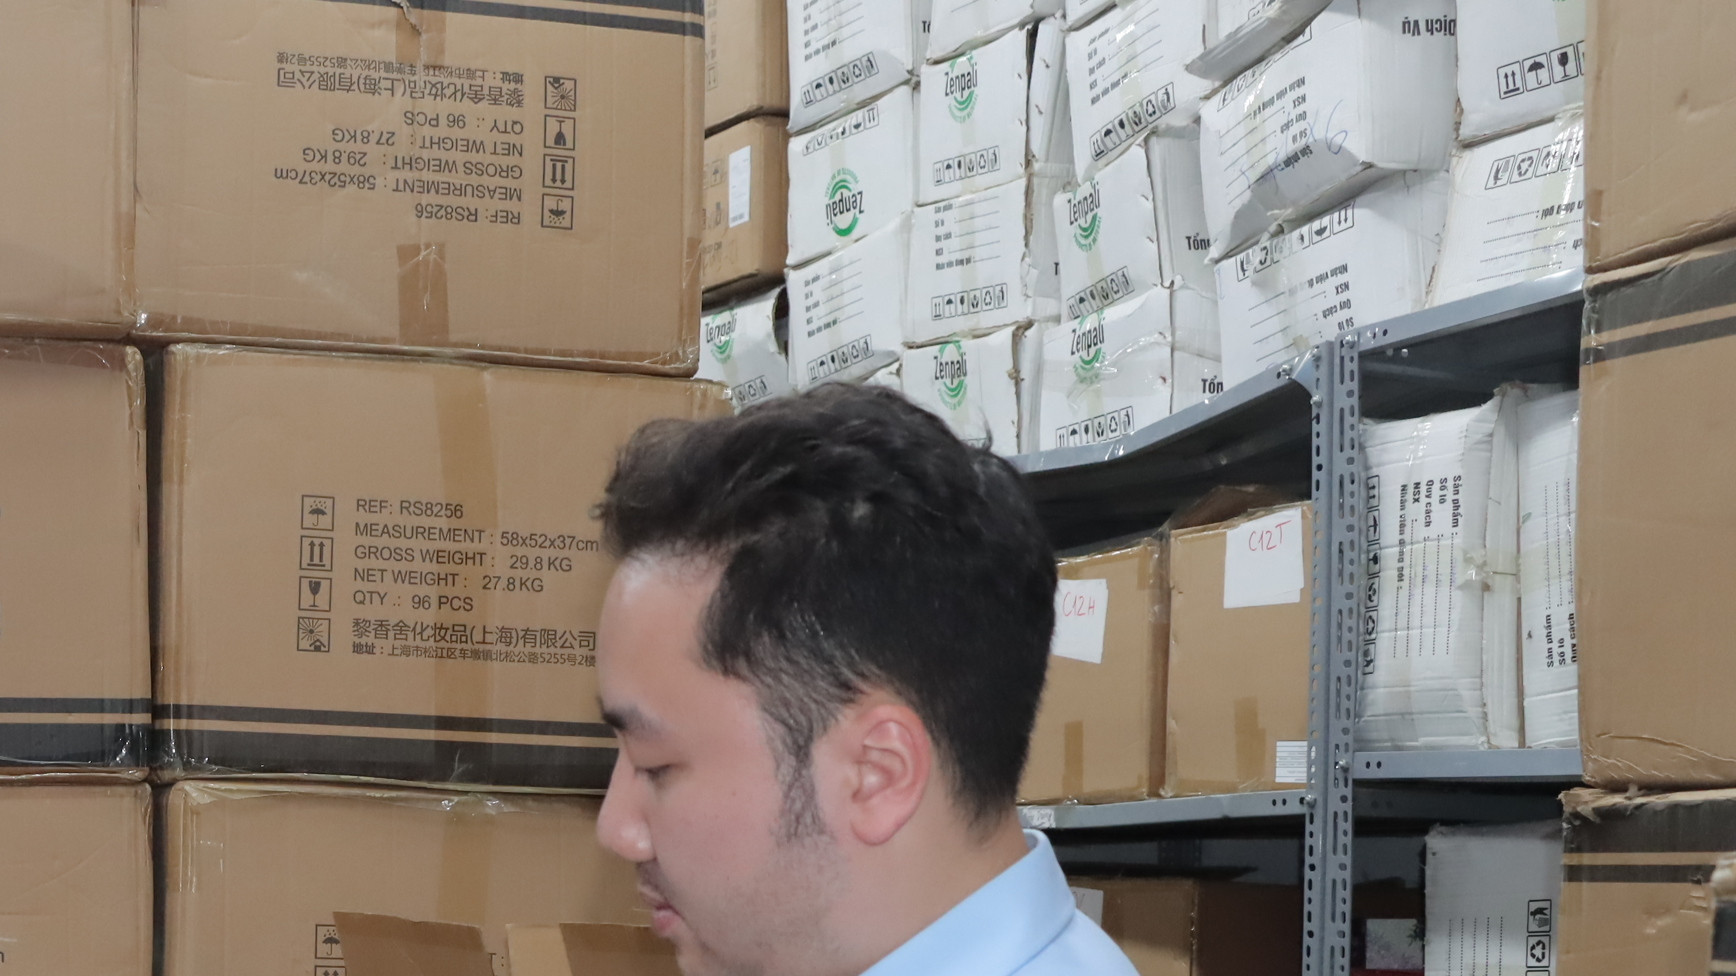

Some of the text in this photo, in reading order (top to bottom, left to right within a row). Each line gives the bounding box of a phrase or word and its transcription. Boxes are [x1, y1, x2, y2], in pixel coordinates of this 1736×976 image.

[944, 62, 978, 99] Zenpali
[403, 110, 440, 127] PCS
[446, 113, 466, 129] 96
[274, 168, 377, 189] 58x52x37cm
[415, 203, 521, 225] REF: RS8256
[825, 190, 865, 227] Zenpali
[1067, 181, 1101, 226] Zenpali
[704, 312, 738, 344] Zenpali
[1070, 317, 1105, 357] Zenpali
[933, 352, 968, 386] Zenpali
[1201, 375, 1224, 394] Tổn
[356, 499, 464, 519] REF: RS8256
[500, 531, 600, 552] 58x52x37cm
[354, 545, 415, 562] GROSS
[353, 568, 387, 584] NET
[411, 594, 431, 610] 96
[438, 595, 474, 612] PCS
